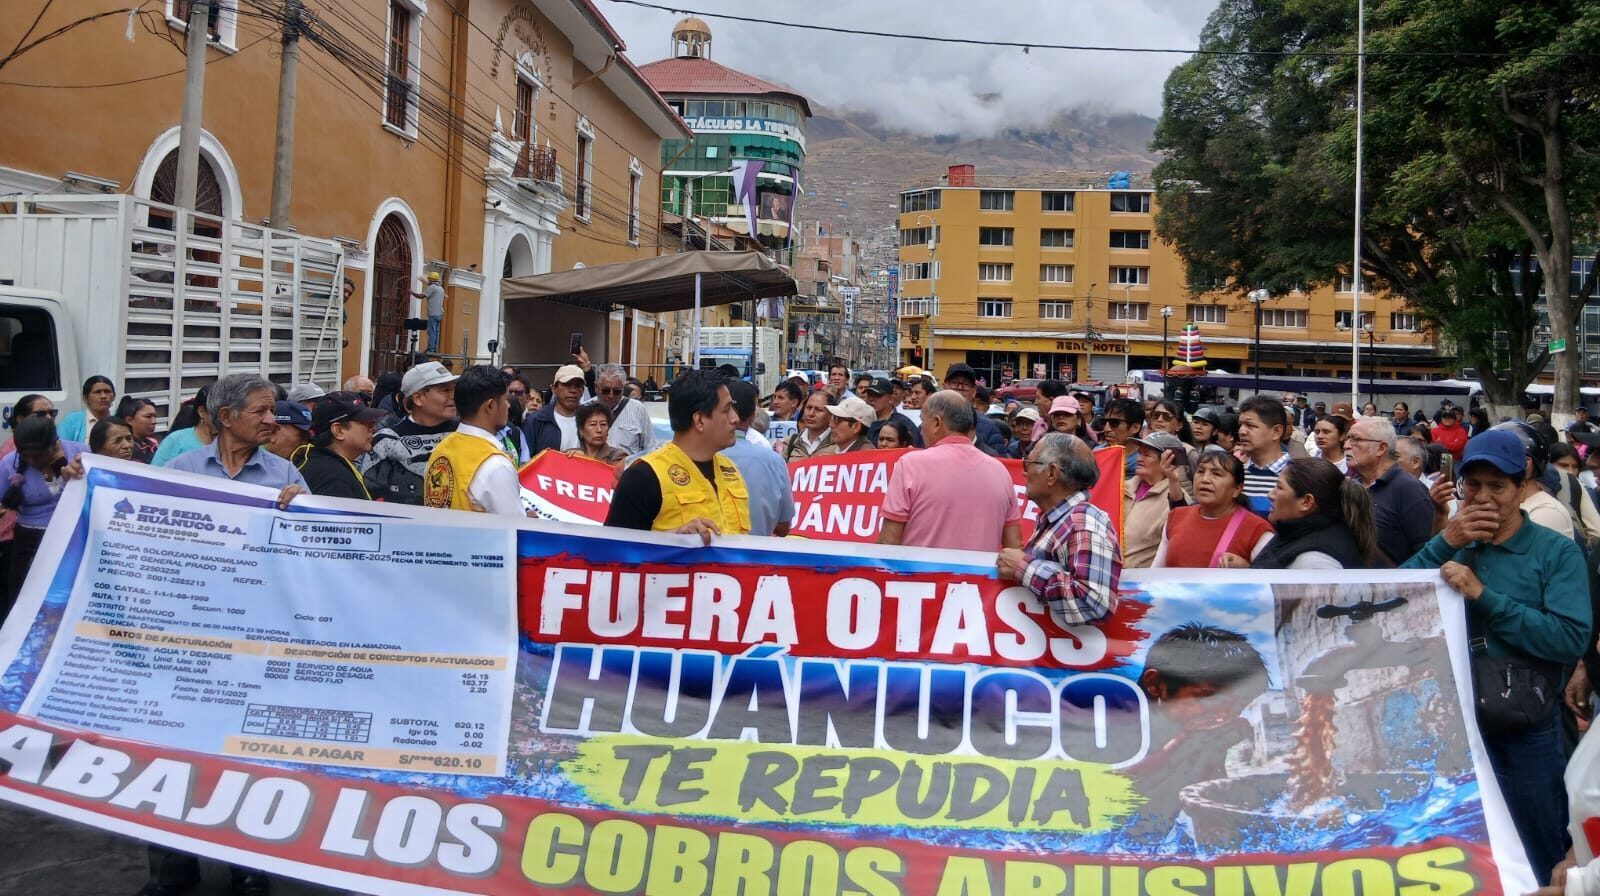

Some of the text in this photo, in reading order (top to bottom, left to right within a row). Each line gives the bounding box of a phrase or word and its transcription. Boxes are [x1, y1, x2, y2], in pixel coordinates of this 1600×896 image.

[684, 117, 742, 130] CTÁCULOS
[745, 119, 761, 131] LA
[1056, 341, 1127, 353] REAL HOTEL
[767, 424, 784, 438] TÉ
[791, 462, 888, 493] MENTA
[536, 474, 615, 504] FREN
[139, 505, 213, 522] EPS SEDA
[136, 514, 216, 531] HUÁNUCO
[218, 525, 247, 536] S.A.
[294, 524, 309, 532] DE
[310, 525, 374, 535] SUMINISTRO
[301, 535, 352, 545] 01017830
[102, 541, 258, 567] CUENCA SOLORZANO MAXIMILIANO
[304, 551, 392, 561] NOVIEMBRE-2025
[126, 553, 138, 561] JR
[140, 555, 183, 567] GENERAL
[185, 562, 217, 571] PRADO
[128, 605, 176, 618] HUANUCO
[538, 567, 1108, 667] FUERA OTASS
[222, 625, 245, 633] HASTA
[109, 629, 233, 649] DATOS DE FACTURACIÓN
[245, 633, 289, 644] SERVICIOS
[290, 638, 338, 648] PRESTADOS
[351, 641, 361, 649] LA
[74, 635, 111, 648] Servicios
[153, 647, 180, 656] AGUA
[189, 650, 233, 661] DESAGUE
[114, 650, 146, 661] DOM(1)
[284, 647, 495, 666] DESCRIPCIÓN DE CONCEPTOS FACTURADOS
[110, 658, 151, 669] VIVIENDA
[152, 663, 209, 675] UNIFAMILIAR
[266, 660, 291, 668] 00001
[296, 662, 335, 672] SERVICIO
[265, 667, 375, 680] 00002 SERVICIO DESAGUE
[294, 675, 324, 683] CARGO
[325, 677, 344, 685] FIJO
[122, 687, 140, 695] 420
[216, 679, 229, 687] 1/2
[236, 681, 262, 690] 15mm
[469, 686, 488, 694] 2.20
[133, 707, 149, 715] 173
[539, 644, 1151, 771] HUÁNUCO
[80, 718, 92, 727] de
[87, 709, 98, 717] de
[147, 718, 185, 729] MEDIDO
[389, 717, 485, 730] SUBTOTAL 620.12
[392, 736, 483, 748] Redondeo -0.02
[464, 731, 484, 739] 0.00
[240, 741, 289, 756] TOTAL
[292, 746, 305, 757] A
[308, 747, 365, 761] PAGAR
[612, 743, 1092, 830] TE REPUDIA
[0, 724, 311, 841] ABAJO
[320, 787, 505, 875] LOS
[520, 812, 902, 896] COBROS
